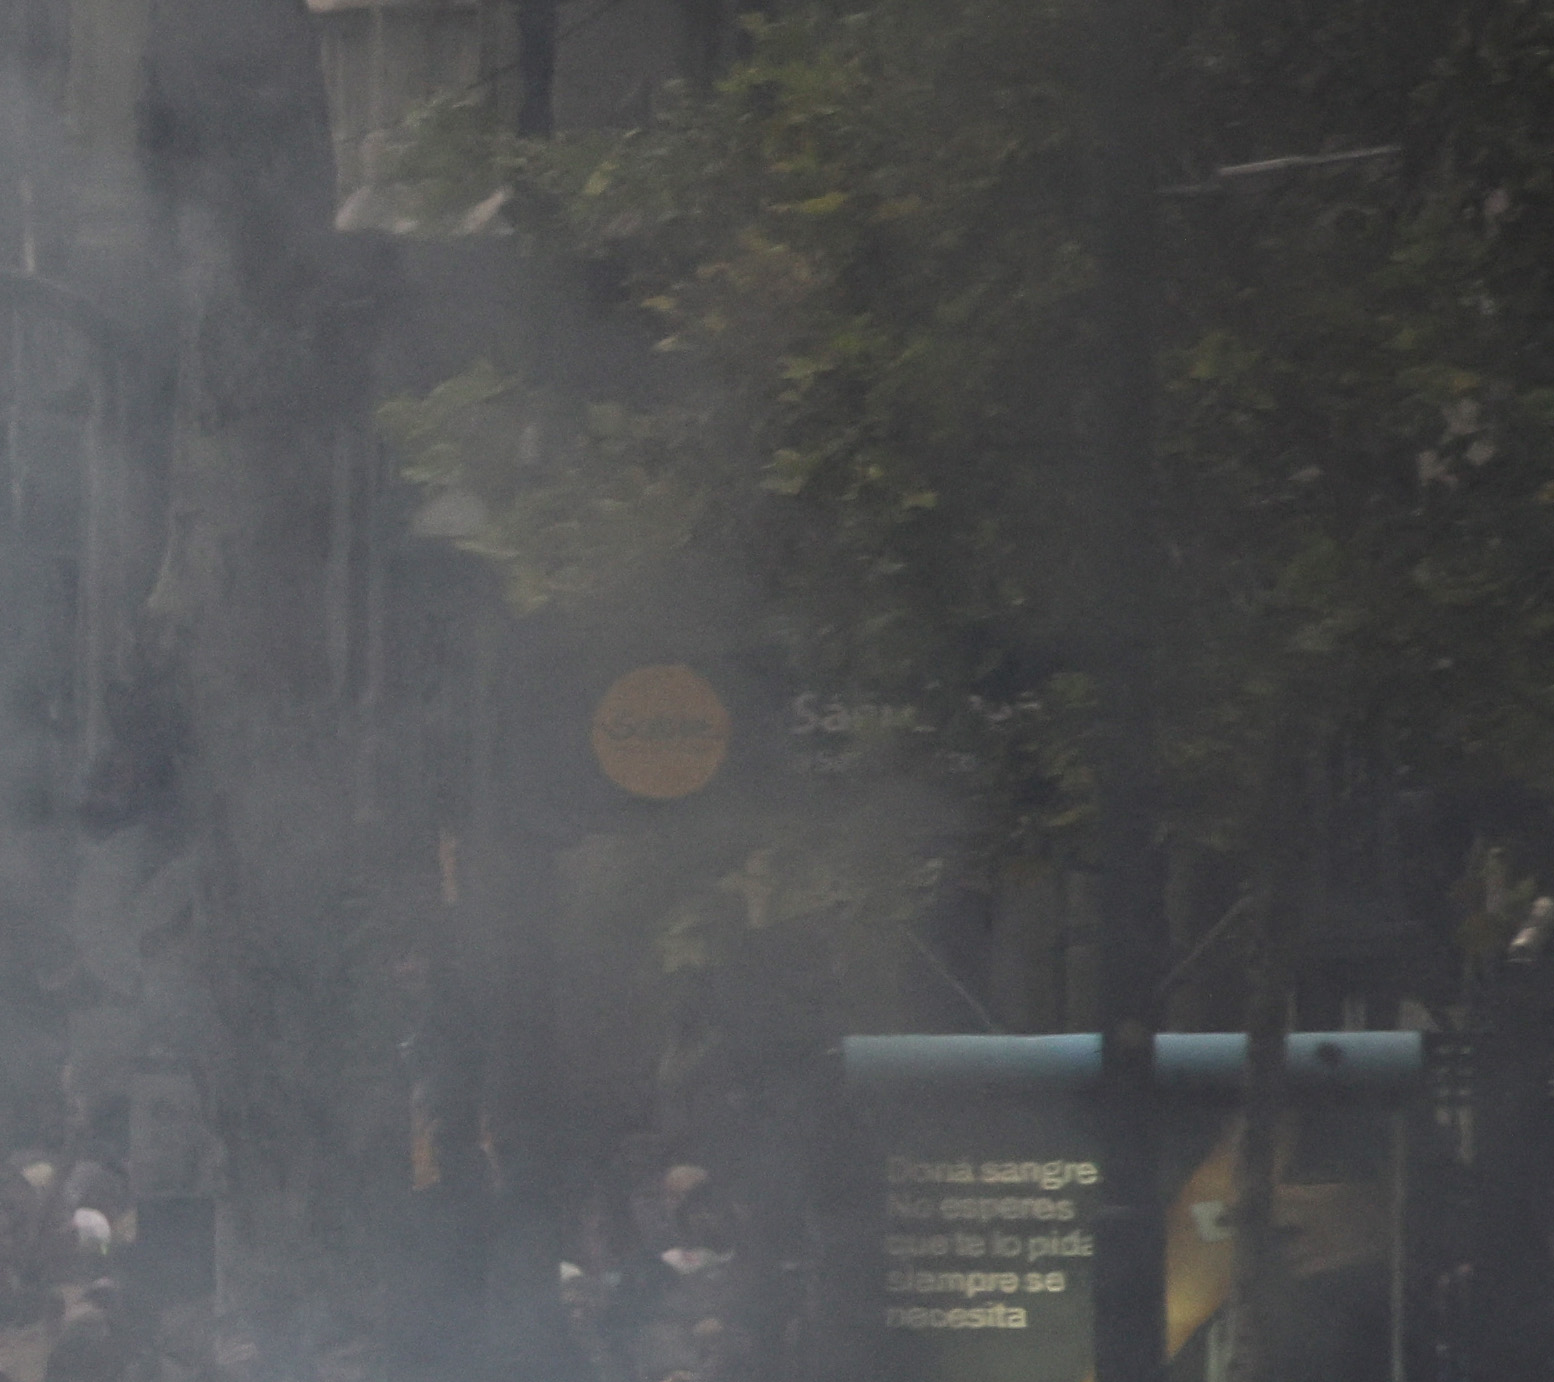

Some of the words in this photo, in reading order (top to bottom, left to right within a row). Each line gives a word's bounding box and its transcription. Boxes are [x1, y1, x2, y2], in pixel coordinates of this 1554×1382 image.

[940, 1197, 1075, 1222] esperes
[887, 1267, 1018, 1298] siempre
[1025, 1272, 1065, 1293] se
[887, 1303, 1027, 1328] necesita
